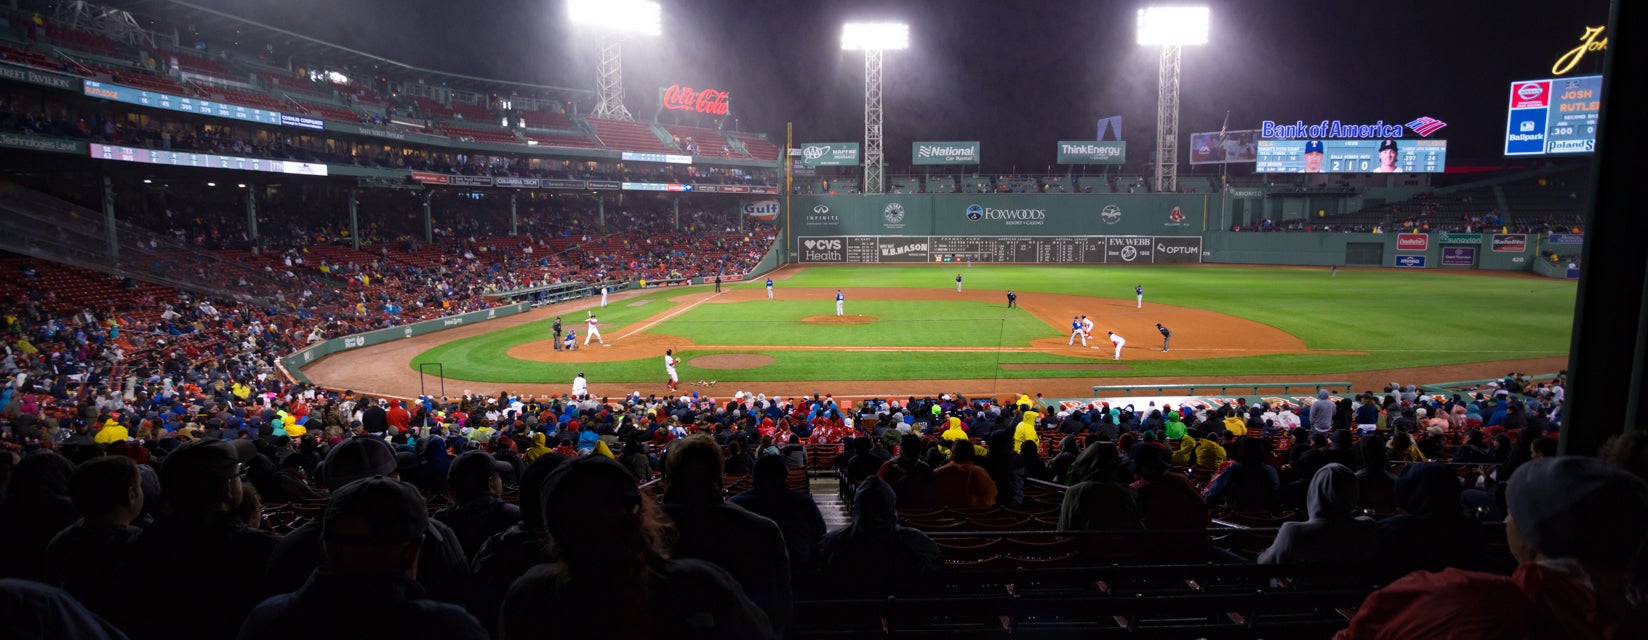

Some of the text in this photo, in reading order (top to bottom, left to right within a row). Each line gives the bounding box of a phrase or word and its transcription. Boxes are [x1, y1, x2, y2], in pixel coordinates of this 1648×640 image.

[29, 70, 70, 88] PAVILION
[664, 84, 730, 115] Coca-Cola
[1561, 90, 1592, 100] JOSH
[1261, 120, 1403, 138] Bank of America
[1551, 126, 1593, 136] .300 0
[1509, 133, 1543, 141] Ballpark
[56, 142, 76, 151] Level
[931, 146, 975, 156] National
[1062, 144, 1120, 156] ThinkEnergy
[1549, 141, 1585, 152] Poland
[222, 160, 228, 168] 2
[1332, 161, 1368, 171] 2 1 0
[523, 178, 537, 186] TECH
[743, 201, 779, 214] Gulf
[985, 207, 1045, 220] FOXWOODS
[816, 239, 841, 250] CVS
[1125, 238, 1151, 246] WEBB
[1166, 246, 1198, 254] OPTUM
[806, 250, 842, 261] Health
